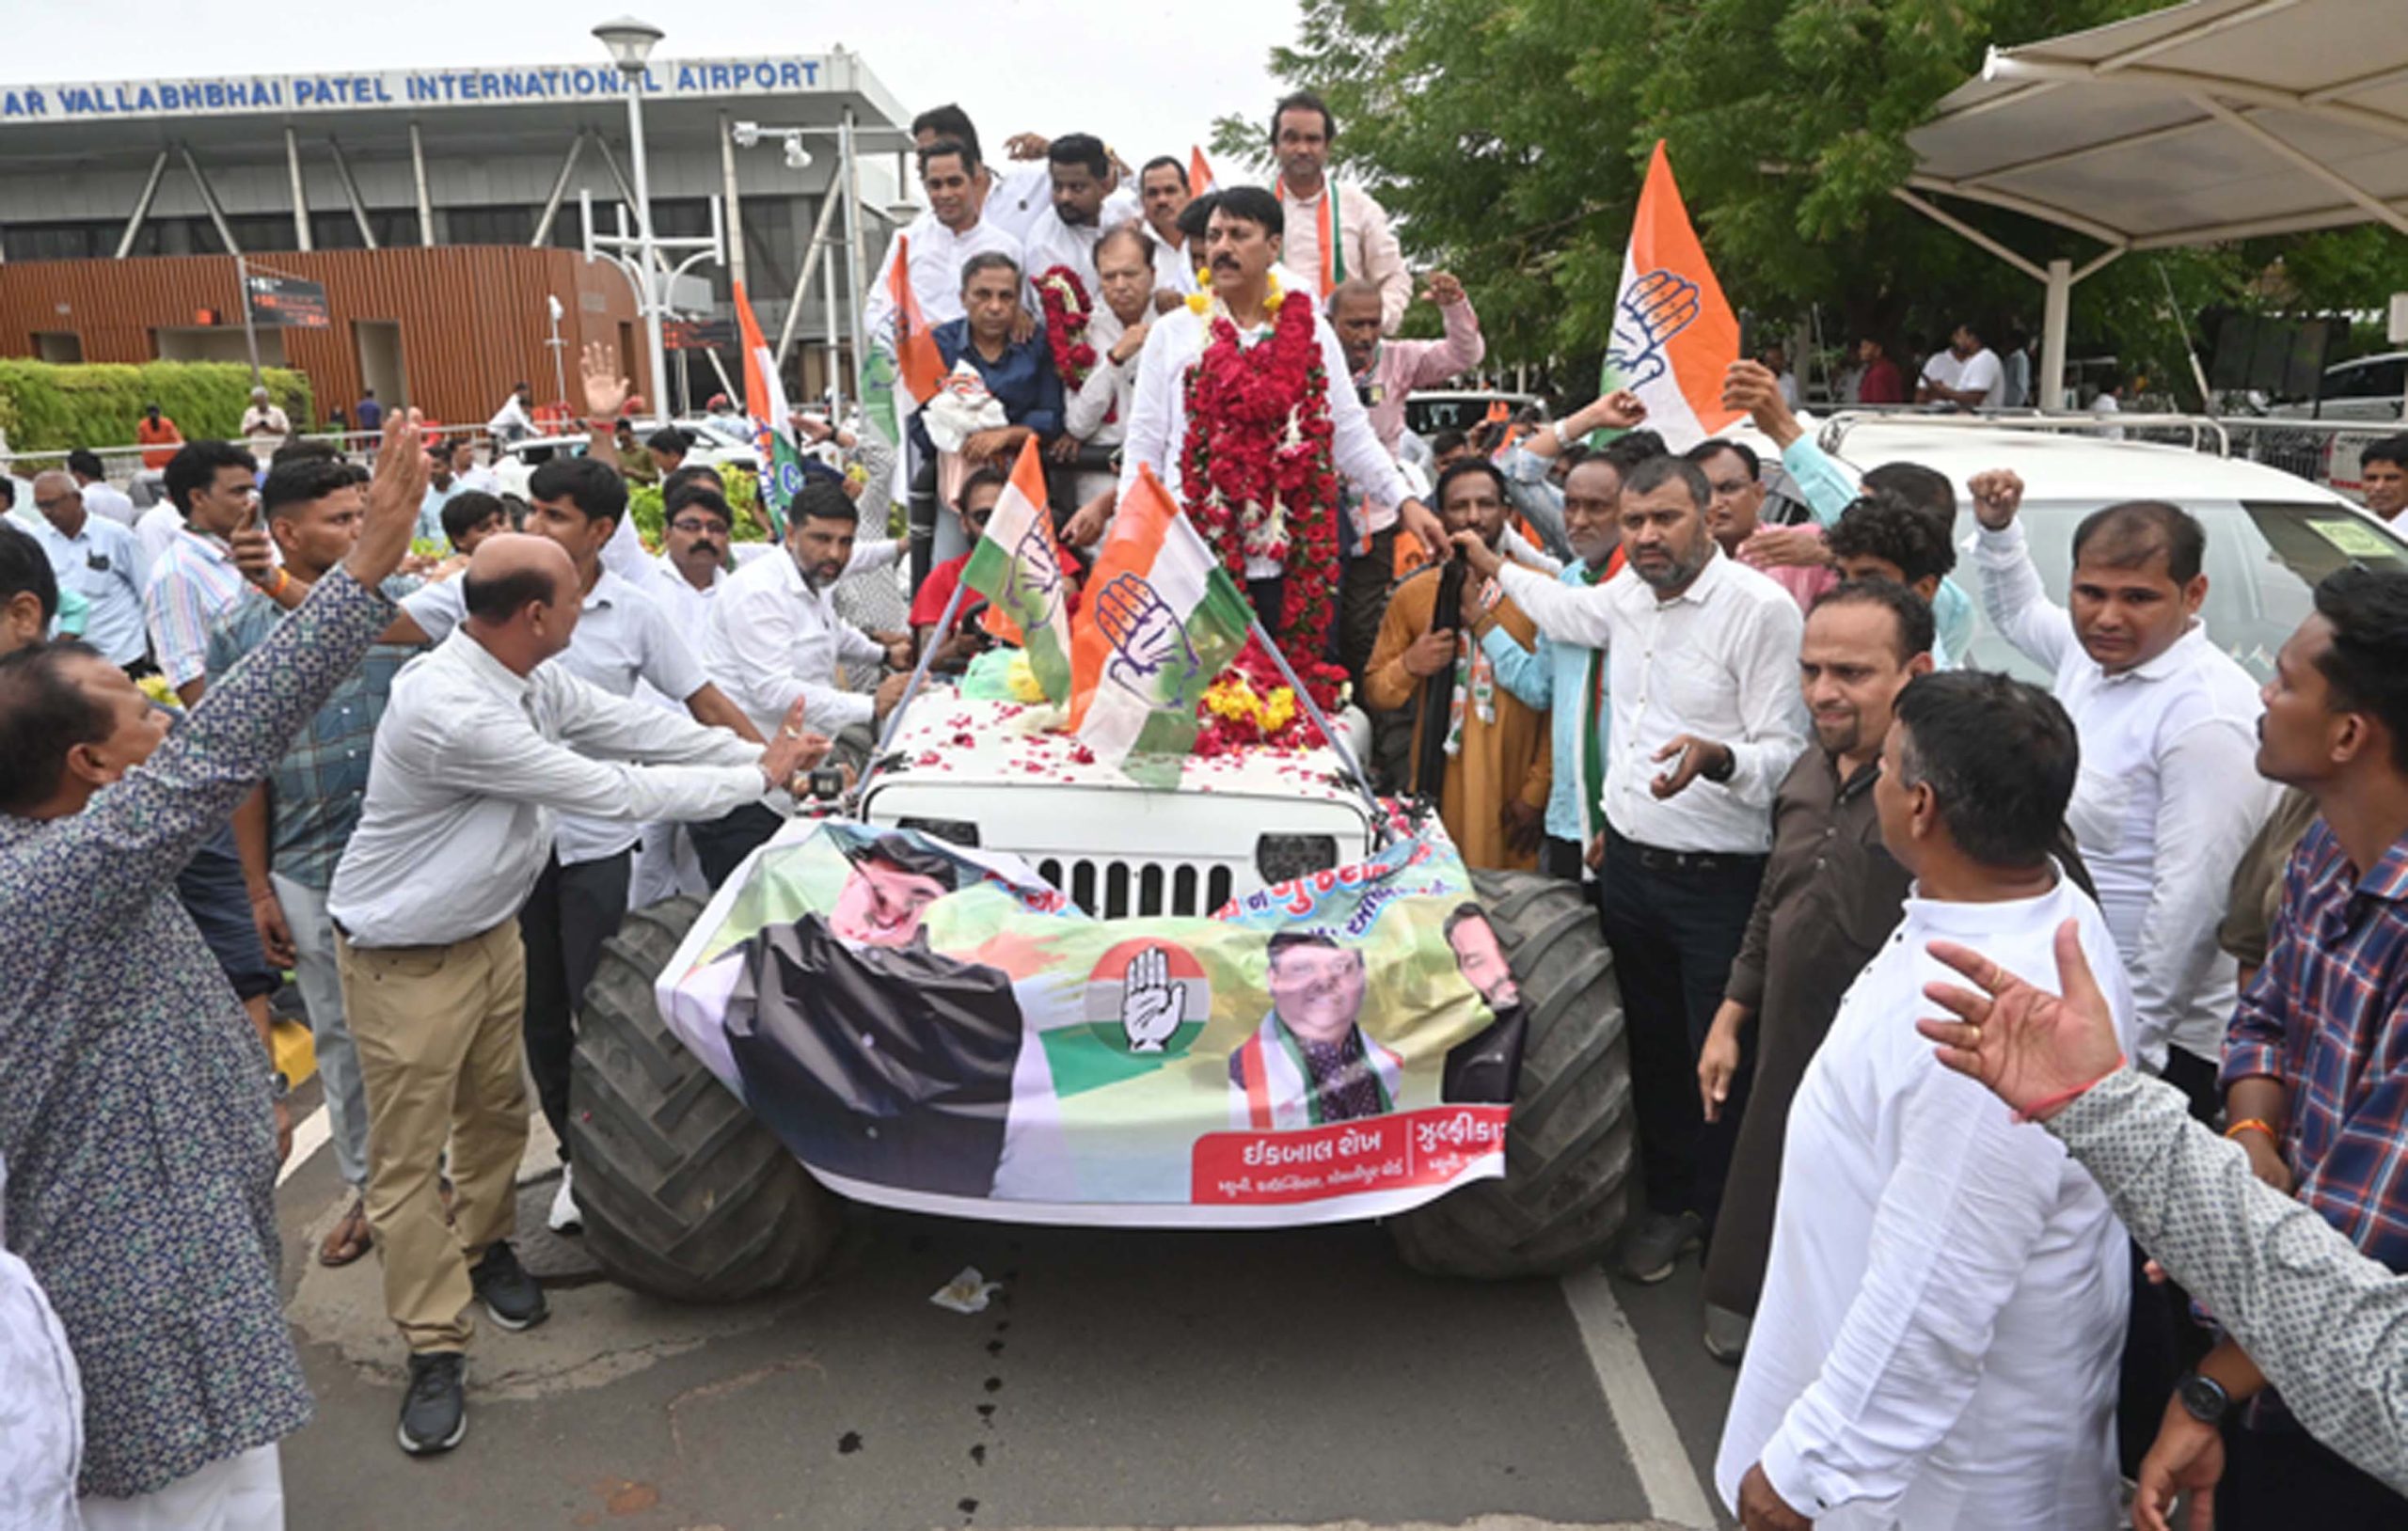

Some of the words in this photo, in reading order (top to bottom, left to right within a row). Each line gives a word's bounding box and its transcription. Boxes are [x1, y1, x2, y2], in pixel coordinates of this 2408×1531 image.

[57, 81, 282, 114] VALLABHBHAI
[293, 77, 392, 105] PATEL
[677, 61, 819, 90] AIRPORT
[1339, 1128, 1382, 1156] શેખ
